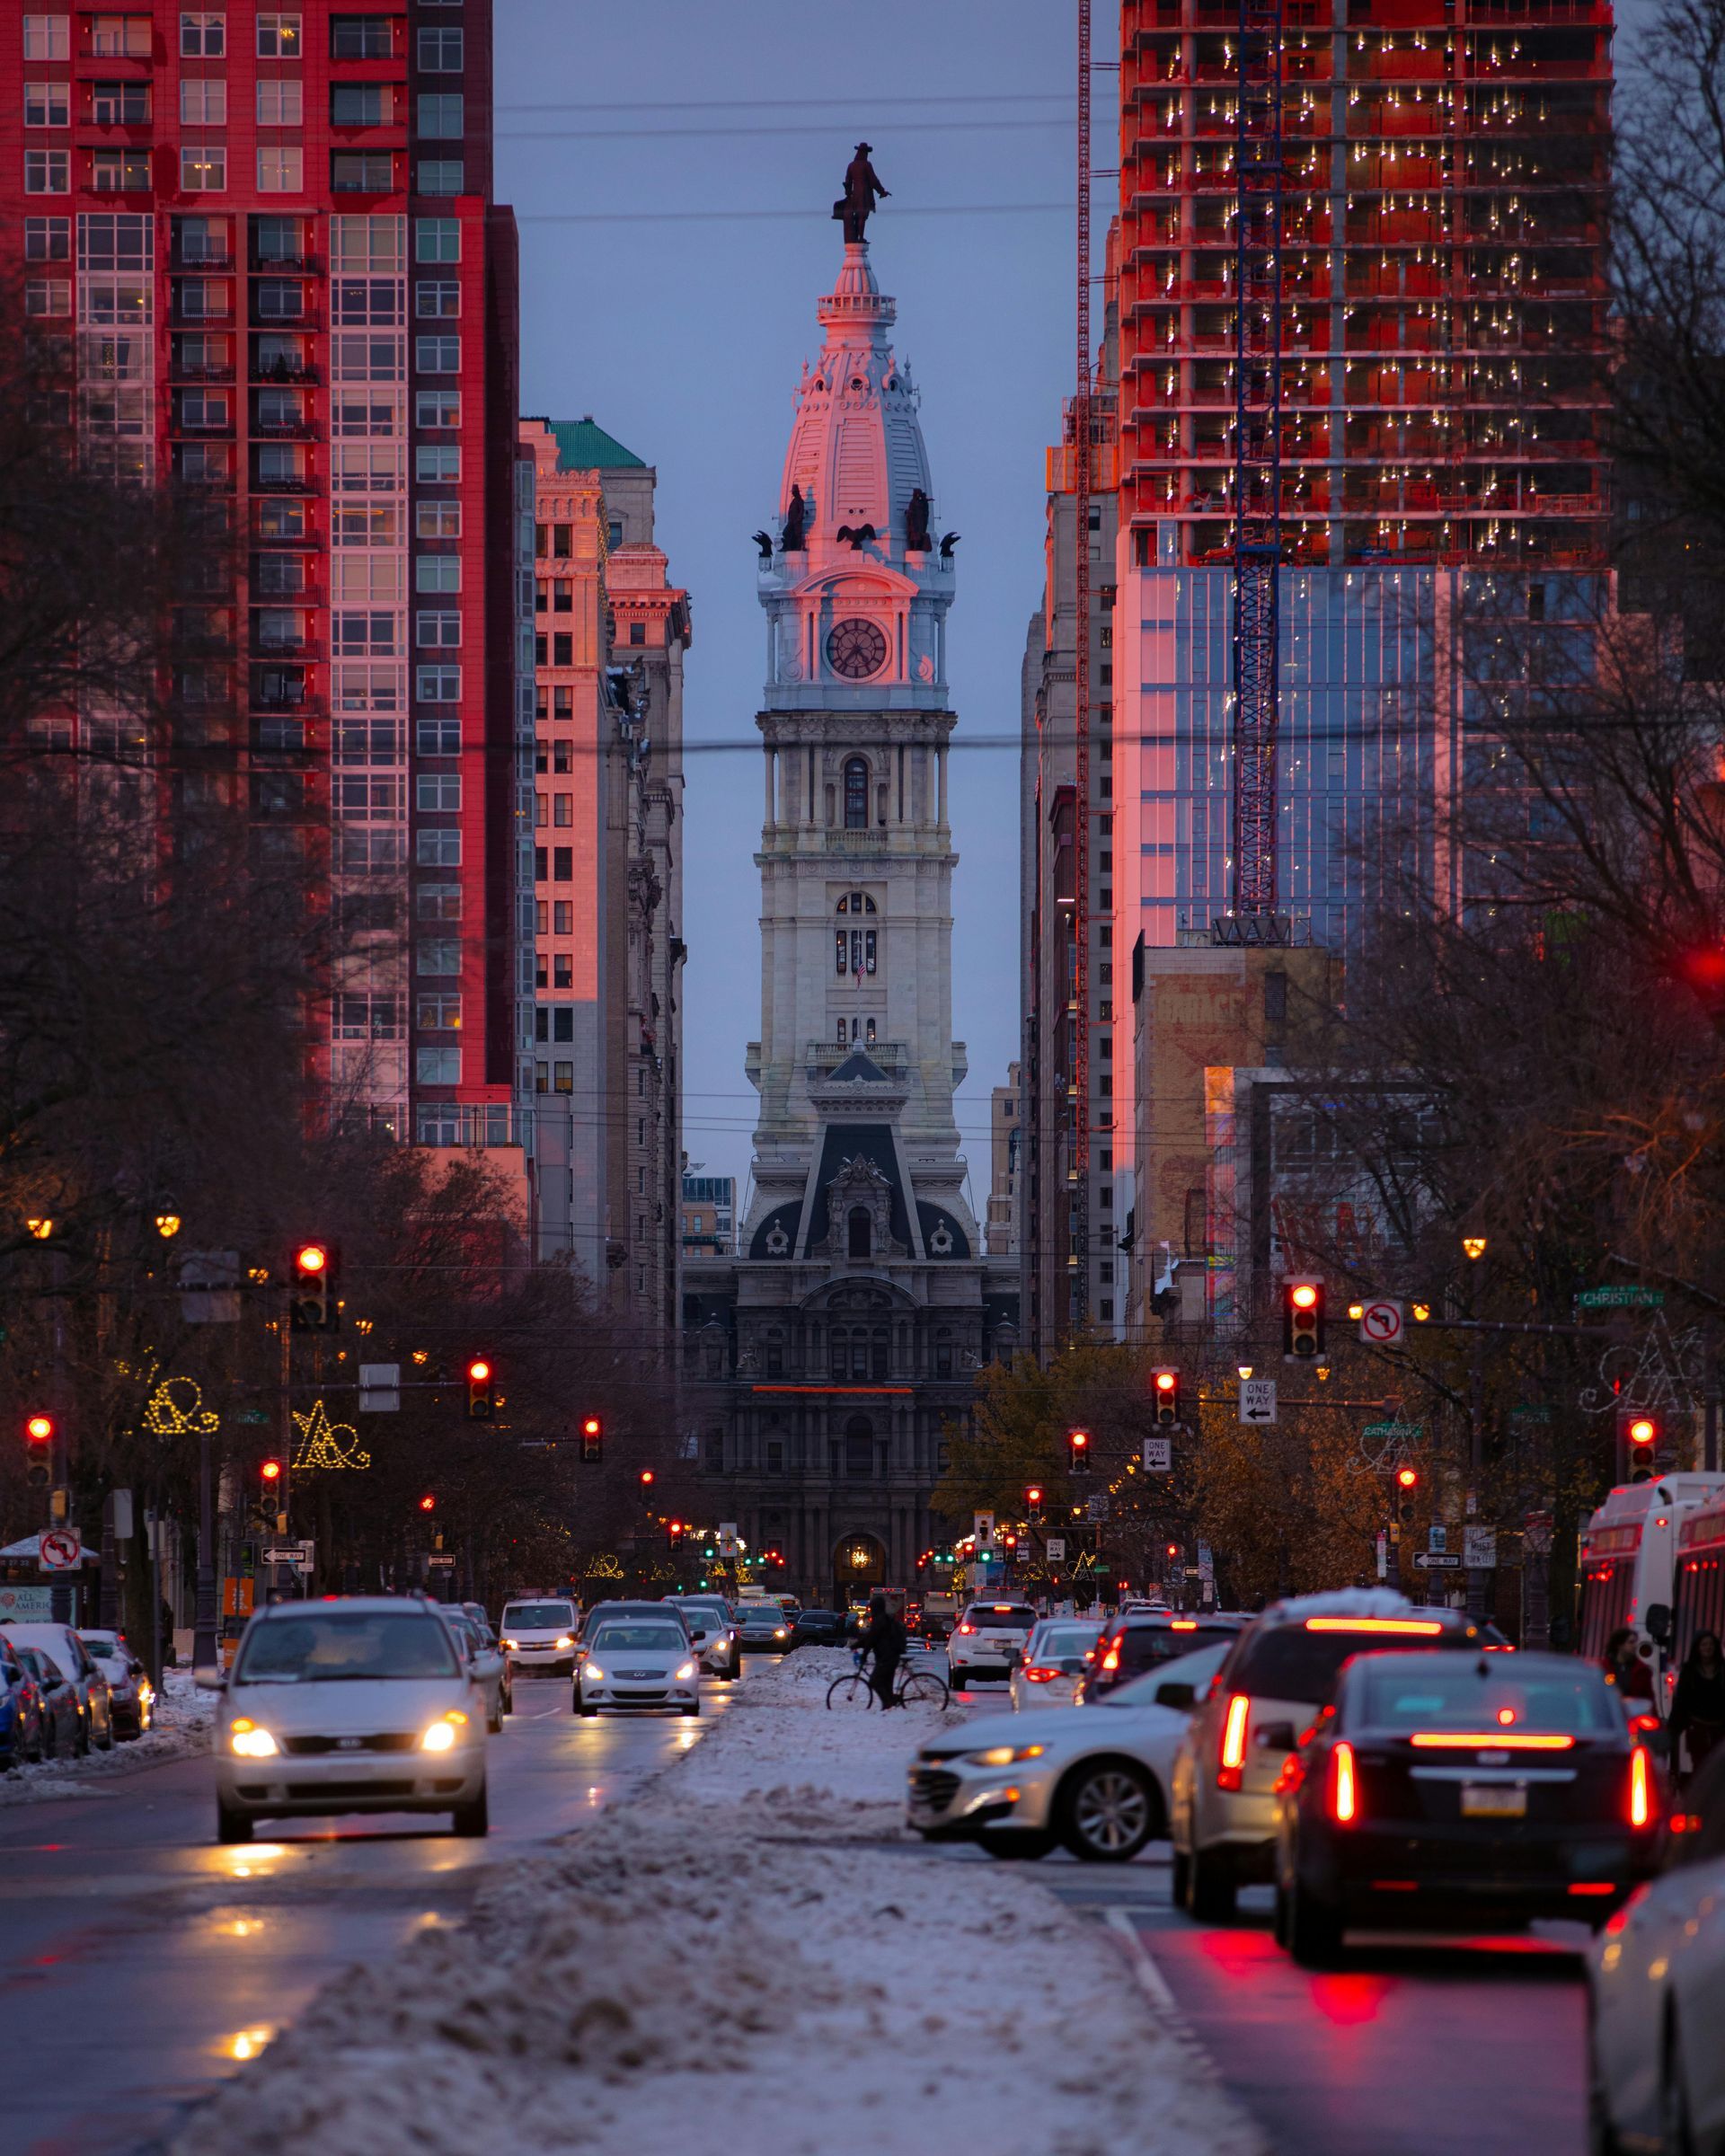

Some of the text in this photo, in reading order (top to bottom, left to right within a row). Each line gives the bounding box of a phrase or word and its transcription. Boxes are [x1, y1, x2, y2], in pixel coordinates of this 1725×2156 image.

[1583, 1293, 1653, 1305] CHRISTIAN
[1247, 1384, 1269, 1394] ONE
[1246, 1395, 1269, 1405] WAY
[1148, 1450, 1165, 1458] WAY
[17, 1594, 35, 1602] ALL
